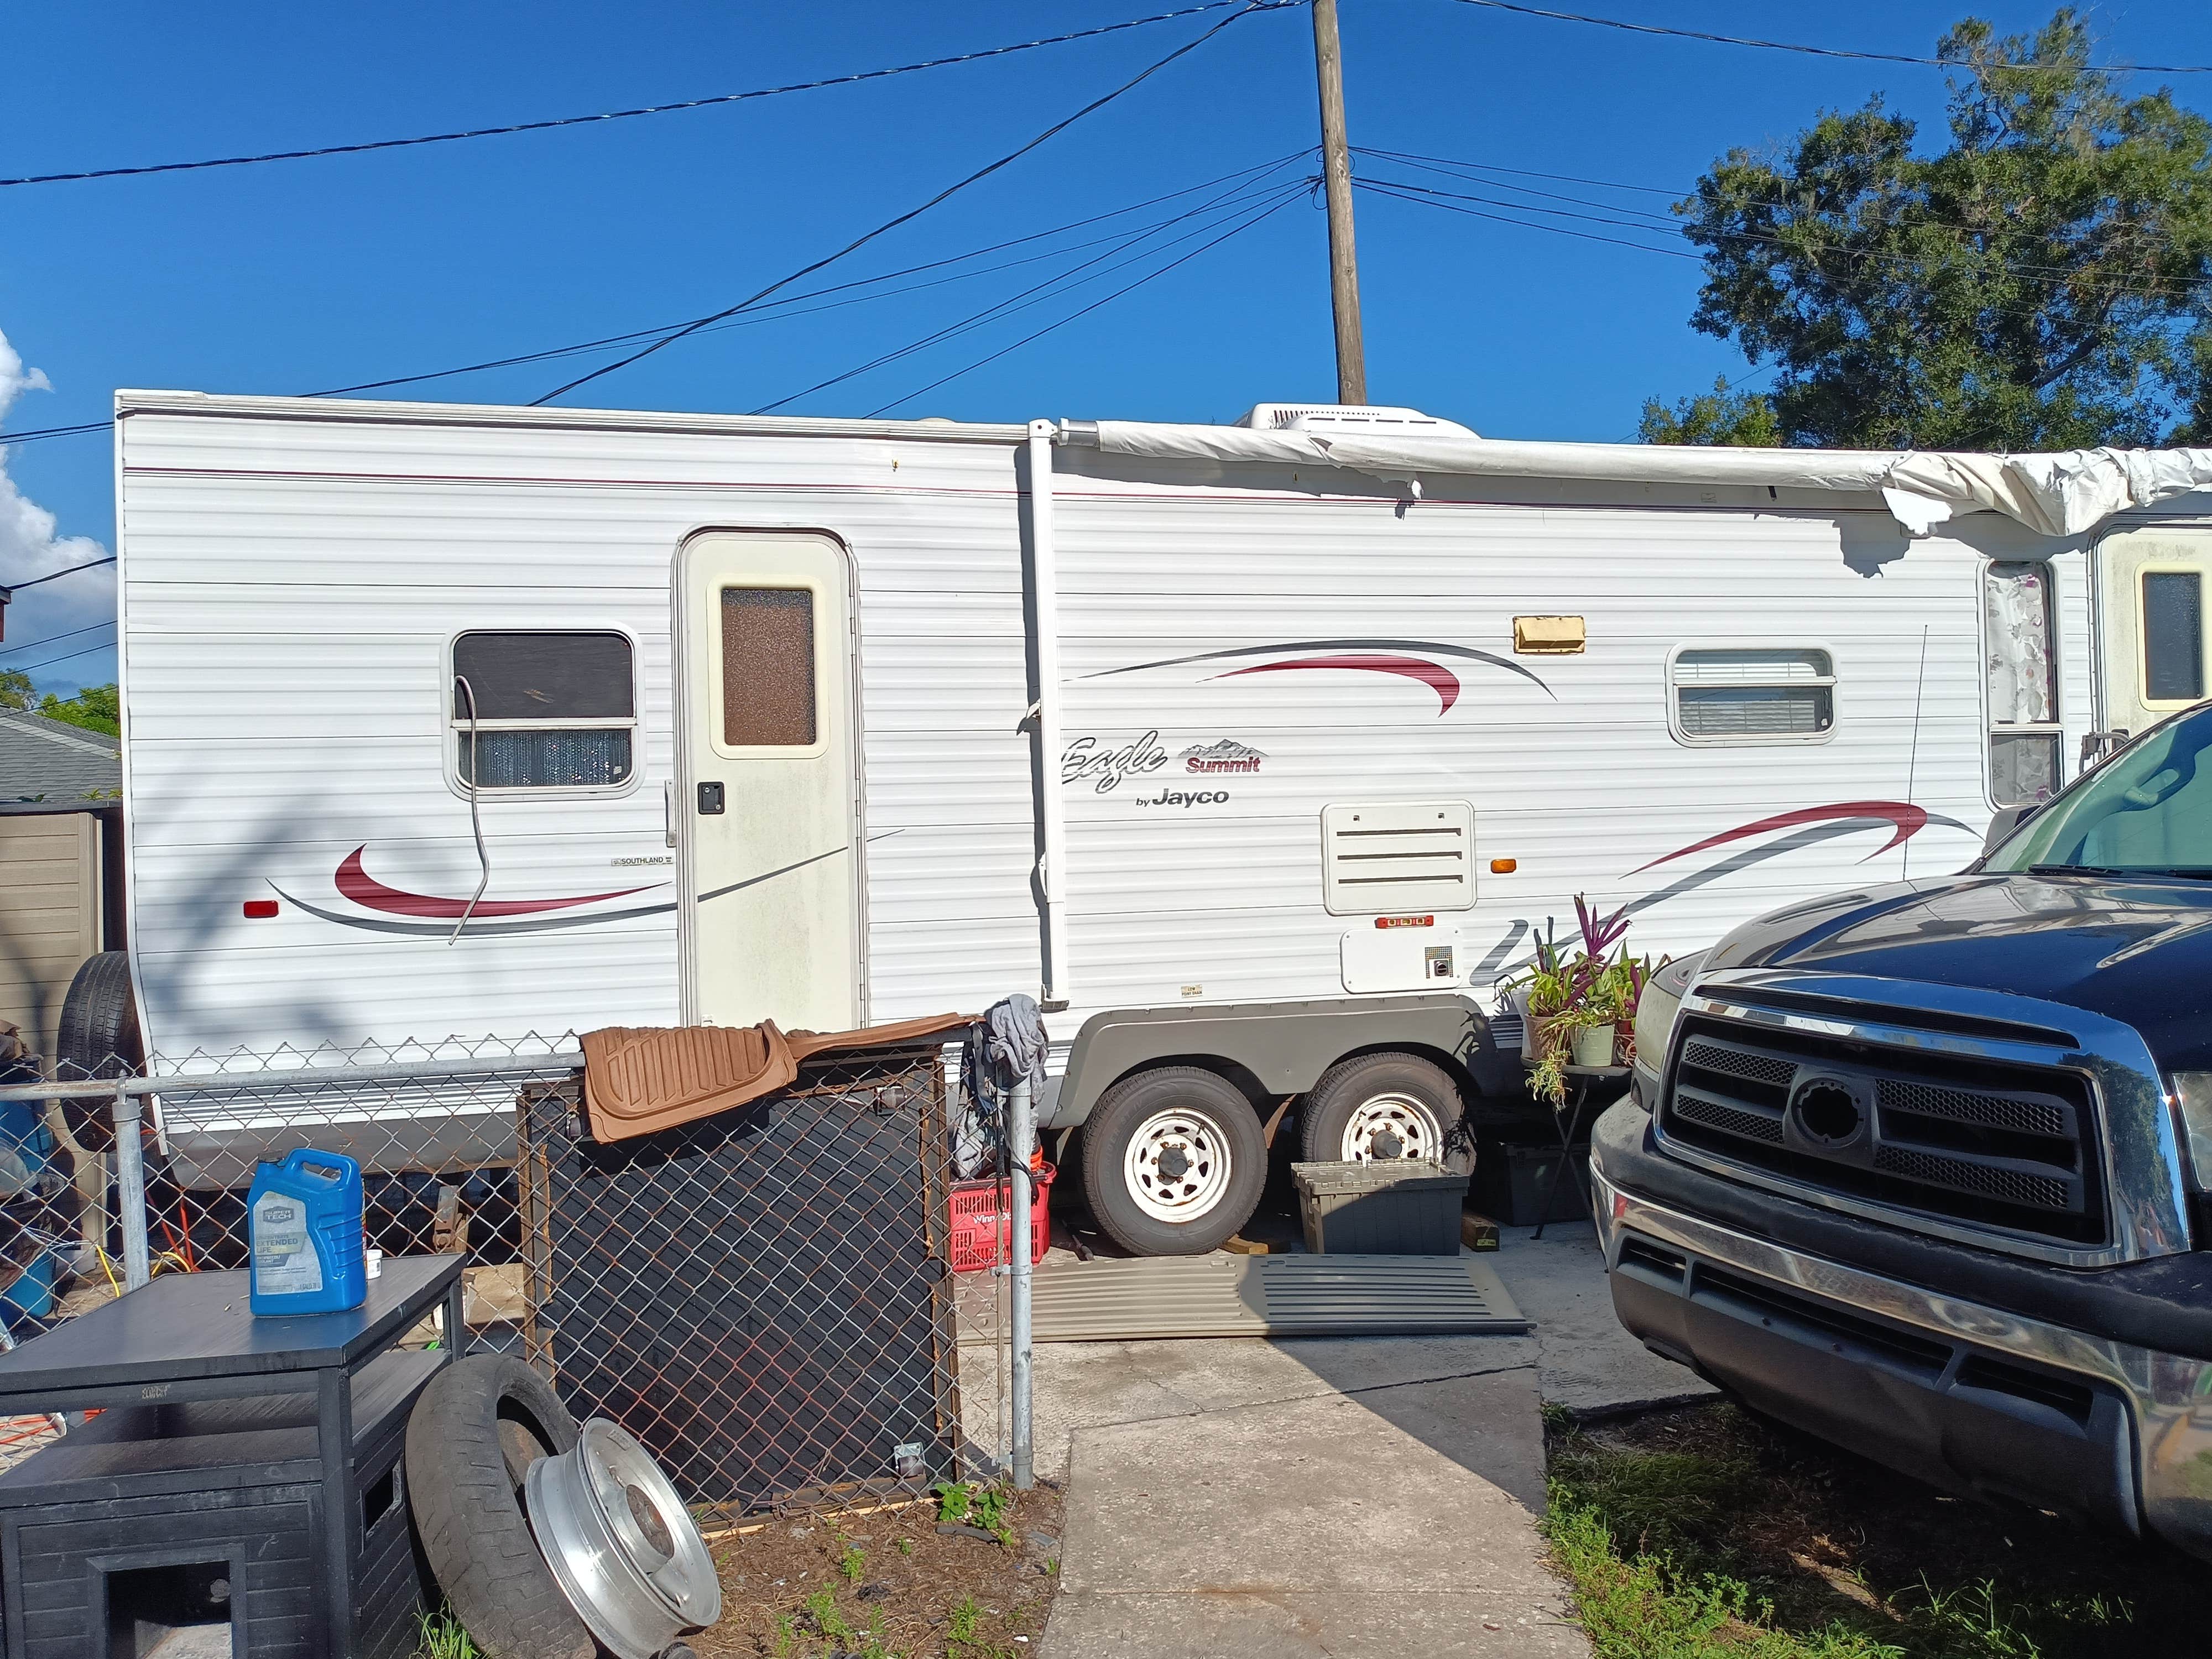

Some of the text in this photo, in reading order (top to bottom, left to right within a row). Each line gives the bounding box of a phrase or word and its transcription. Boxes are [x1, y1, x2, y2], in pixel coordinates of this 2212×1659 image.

[1061, 730, 1261, 794] Eagle Summit
[1135, 787, 1229, 808] by Jayco
[256, 1239, 298, 1247] EXTENDED
